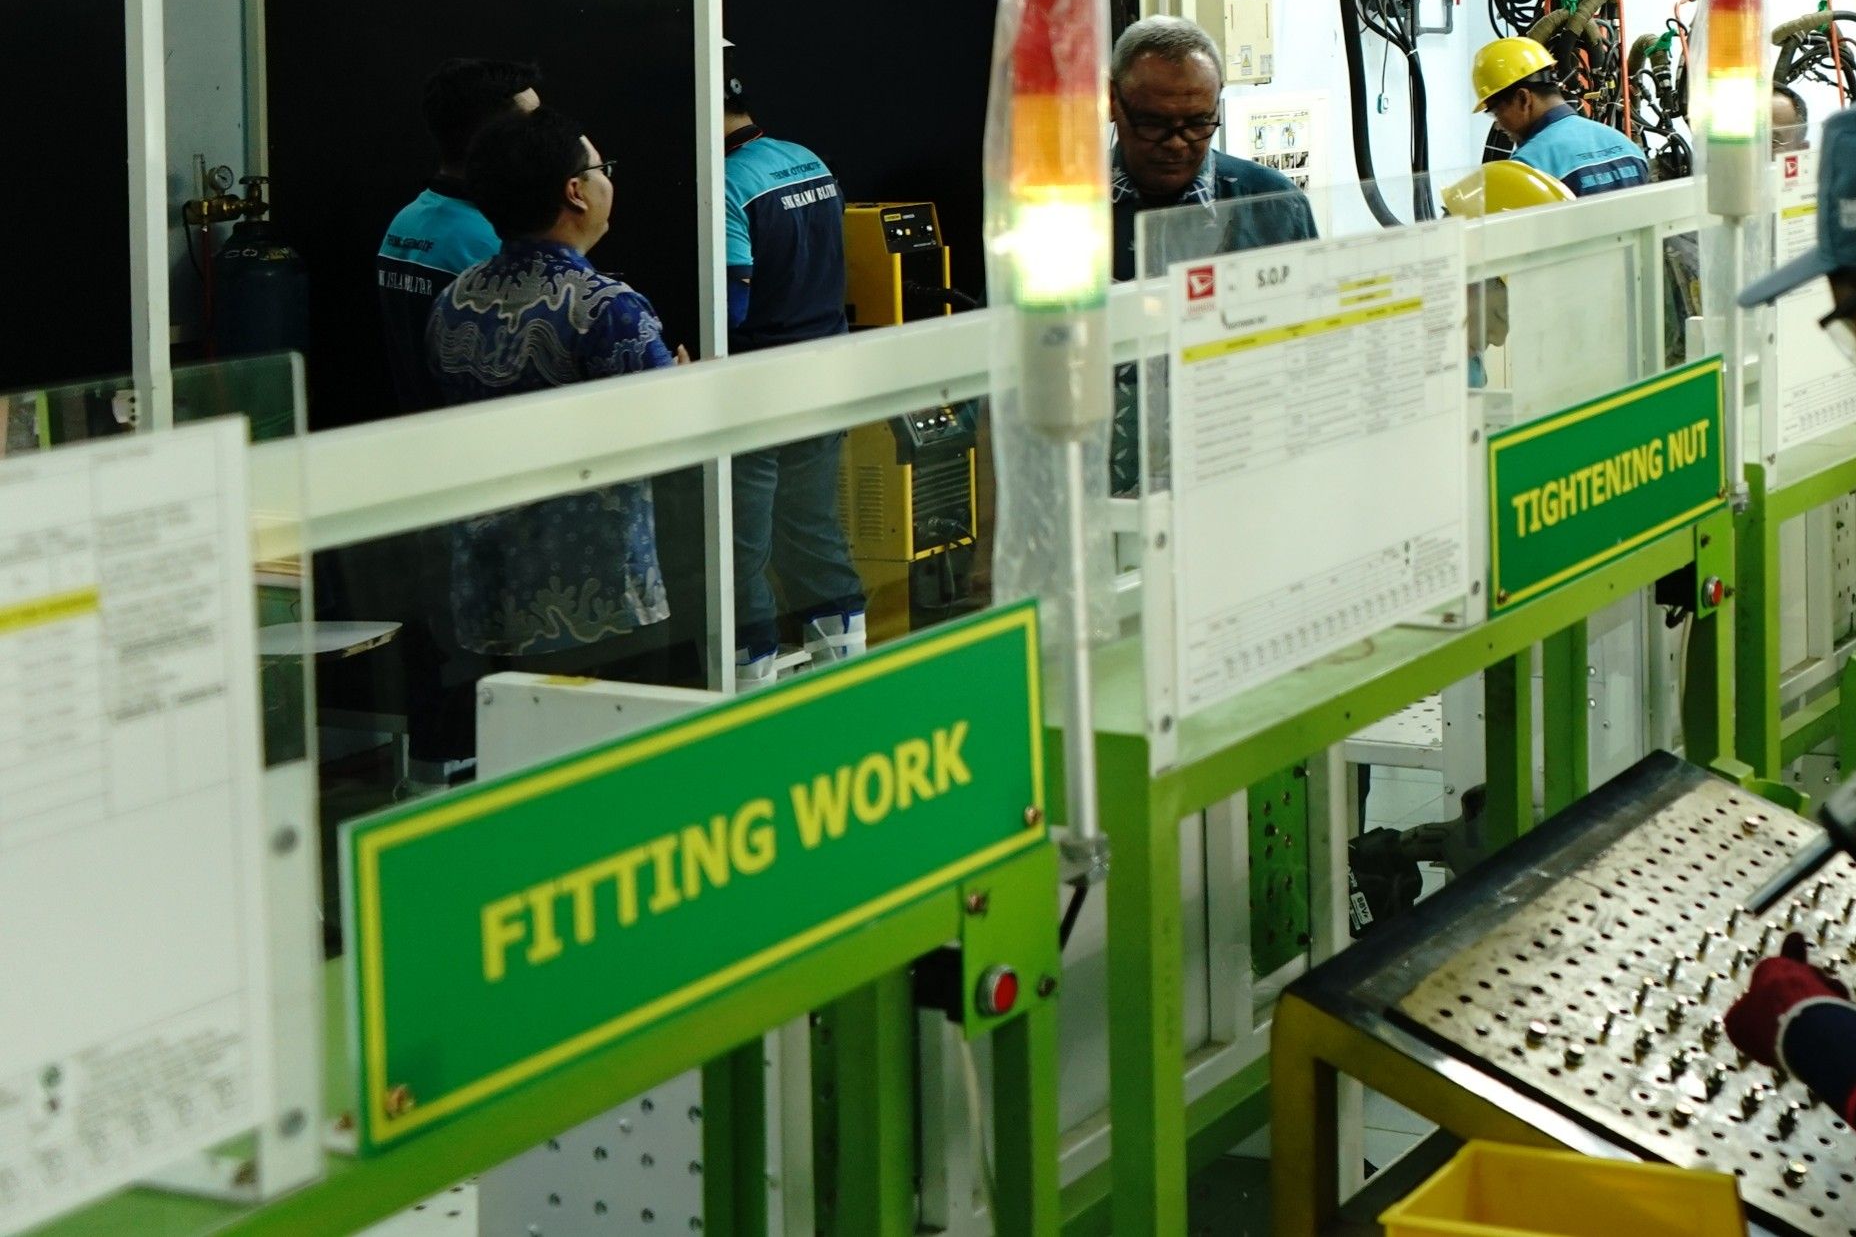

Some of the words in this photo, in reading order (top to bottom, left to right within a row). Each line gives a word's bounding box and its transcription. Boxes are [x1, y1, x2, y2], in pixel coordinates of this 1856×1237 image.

[1511, 438, 1664, 538] TIGHTENING
[1667, 418, 1710, 472] NUT
[480, 798, 777, 982] FITTING
[790, 720, 972, 850] WORK
